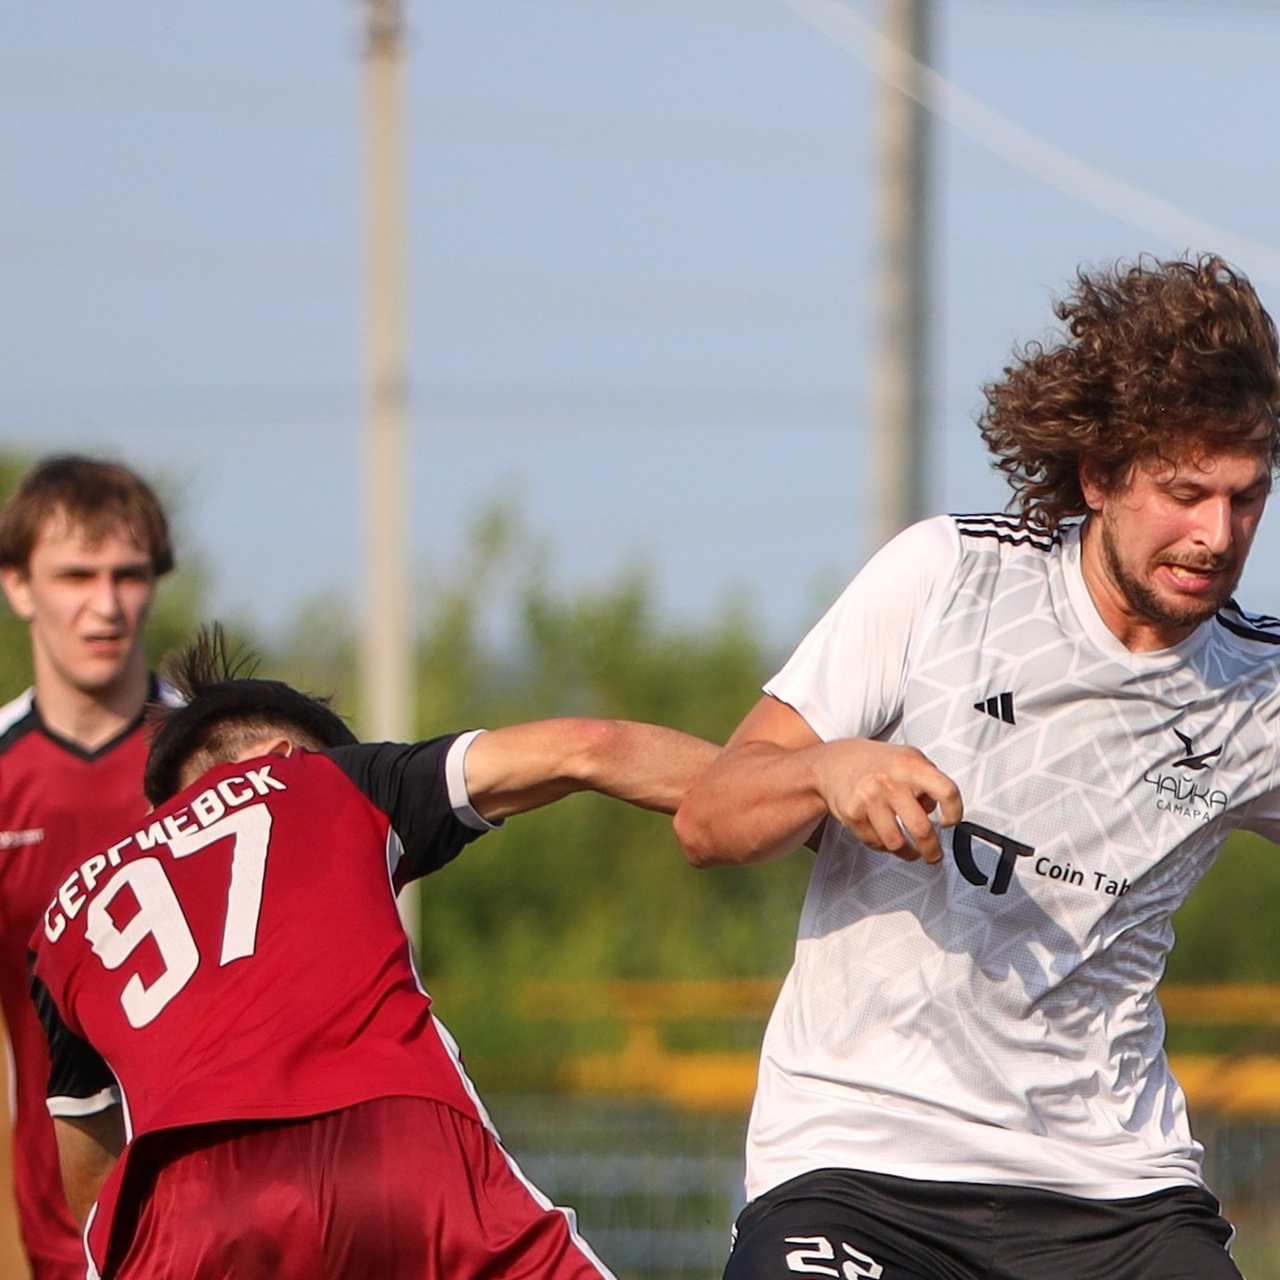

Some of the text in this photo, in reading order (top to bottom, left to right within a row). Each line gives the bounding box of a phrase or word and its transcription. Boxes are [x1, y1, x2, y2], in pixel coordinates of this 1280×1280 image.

[1143, 769, 1228, 812] ЧАЙКА
[1156, 799, 1211, 822] САМАРА
[45, 765, 287, 943] СЕРГИЕВСК
[1035, 857, 1084, 887] Coin
[84, 802, 273, 1029] 97
